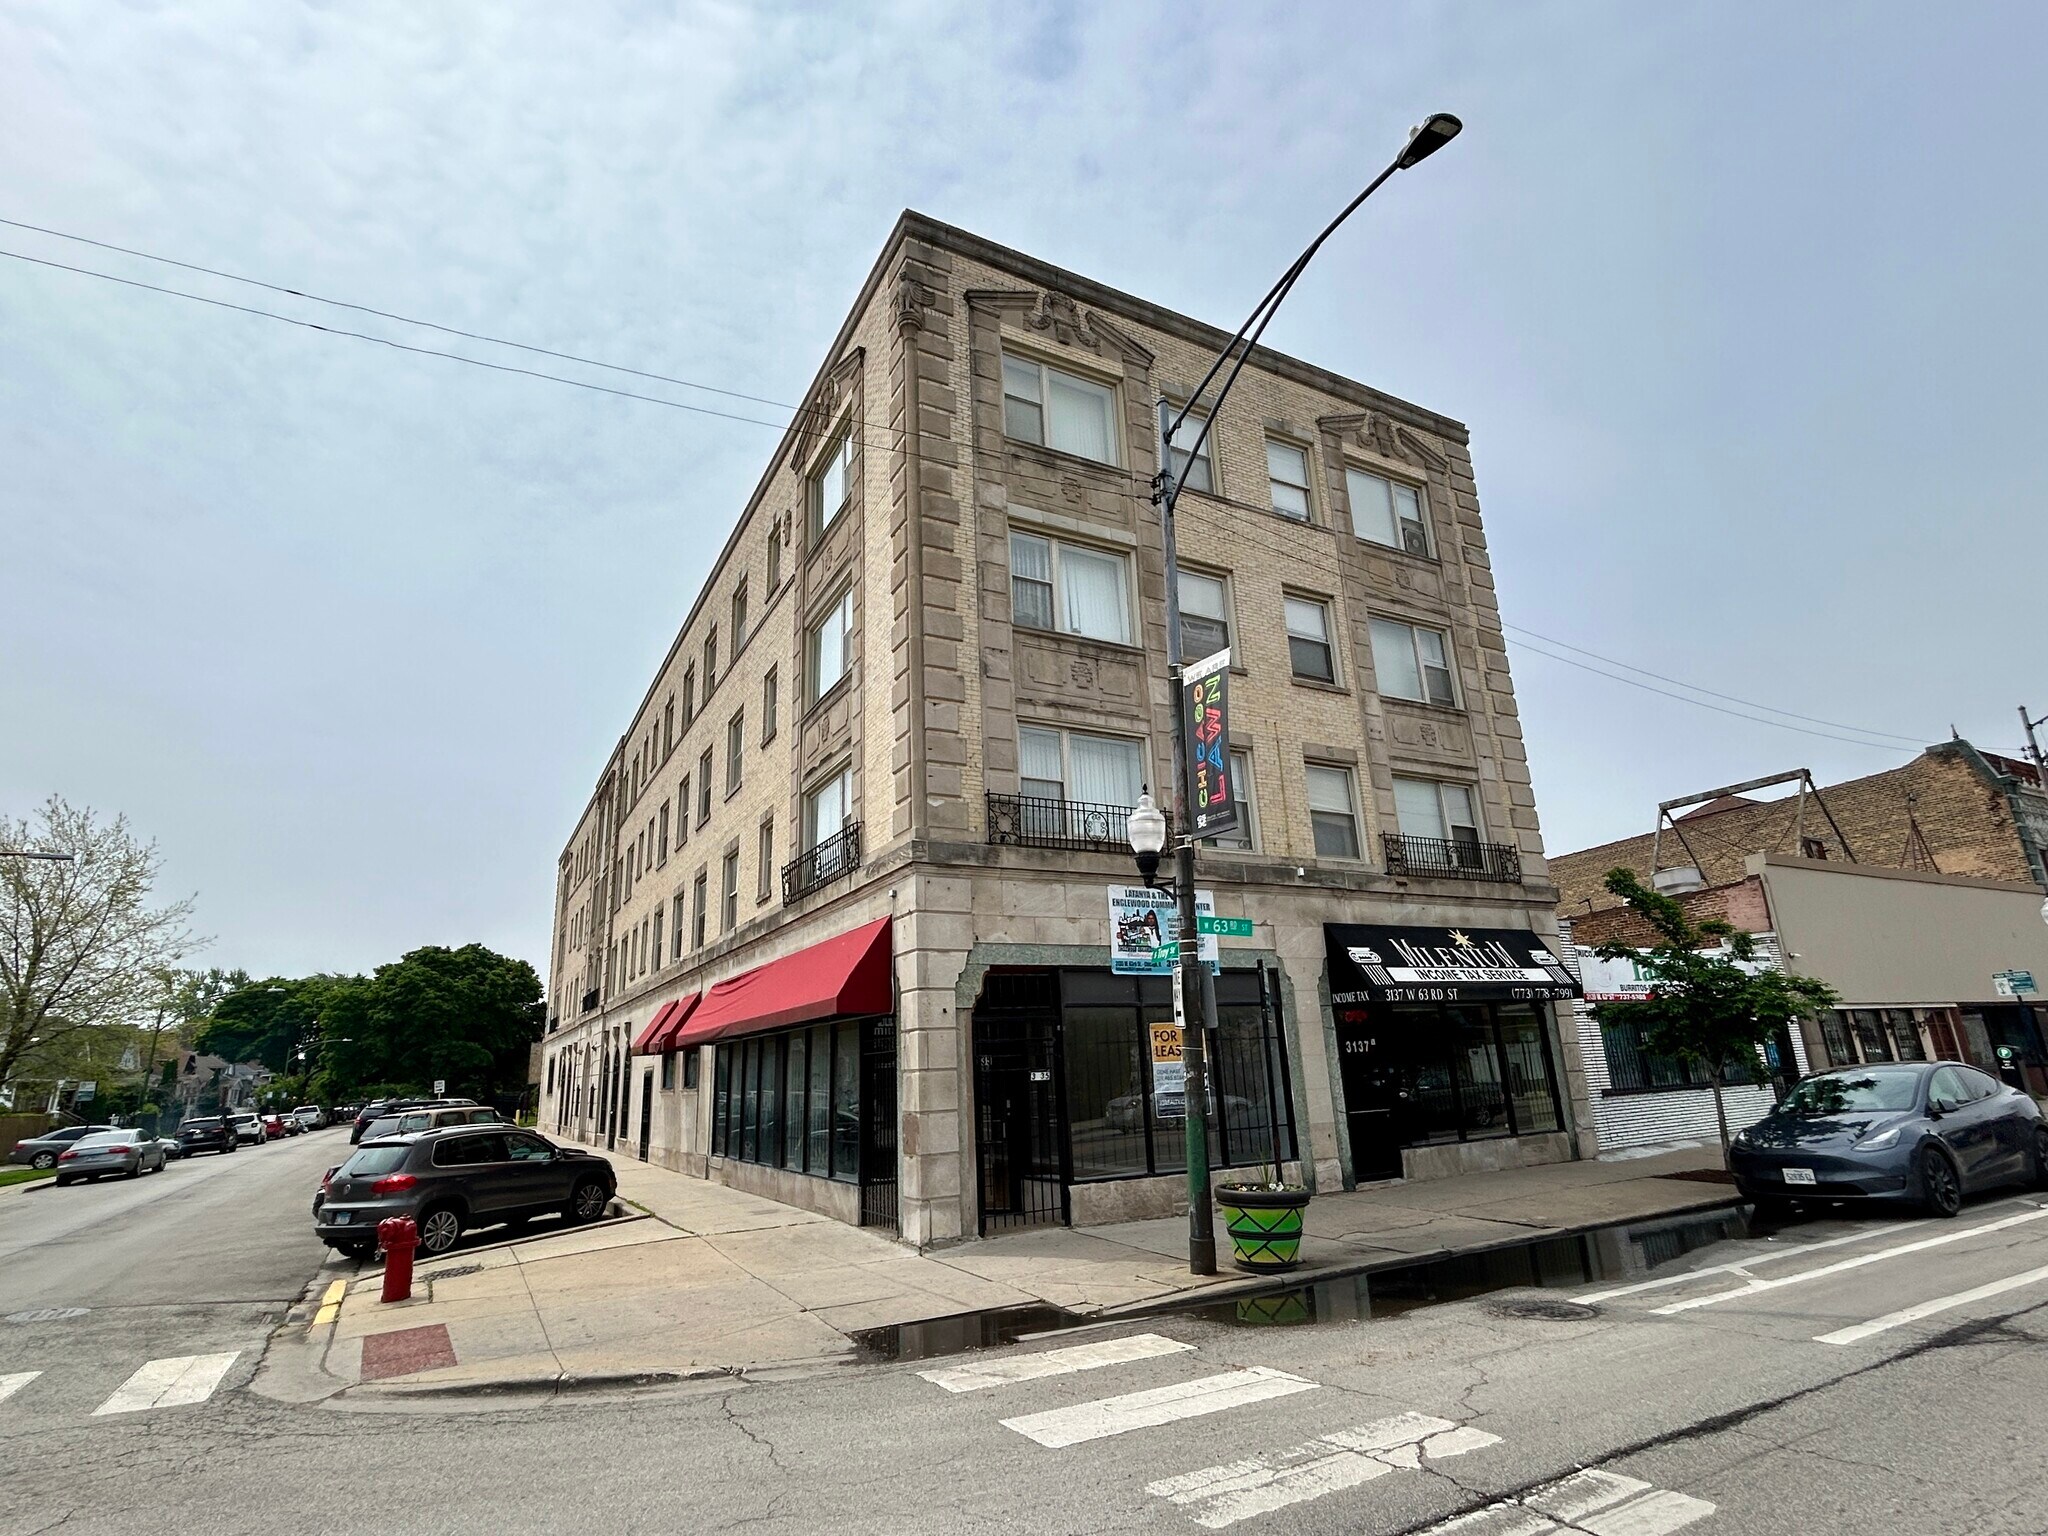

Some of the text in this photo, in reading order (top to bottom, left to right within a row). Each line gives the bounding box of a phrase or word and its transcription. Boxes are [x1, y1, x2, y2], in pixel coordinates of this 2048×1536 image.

[1193, 683, 1208, 808] CHICAGO
[1205, 674, 1227, 805] LAWN
[1112, 898, 1150, 908] ENGLEWOOD
[1158, 948, 1169, 959] Troy
[1388, 938, 1520, 968] MILENIUM
[1414, 969, 1529, 980] INCOME TAX SERVICE
[1356, 990, 1369, 1002] TAX
[1385, 988, 1403, 1001] 3137
[1406, 988, 1415, 1001] W
[1447, 988, 1458, 1000] ST
[1511, 988, 1534, 999] (773)
[1154, 1030, 1178, 1042] FOR
[1155, 1045, 1183, 1057] LEAS
[1345, 1040, 1369, 1053] 3137
